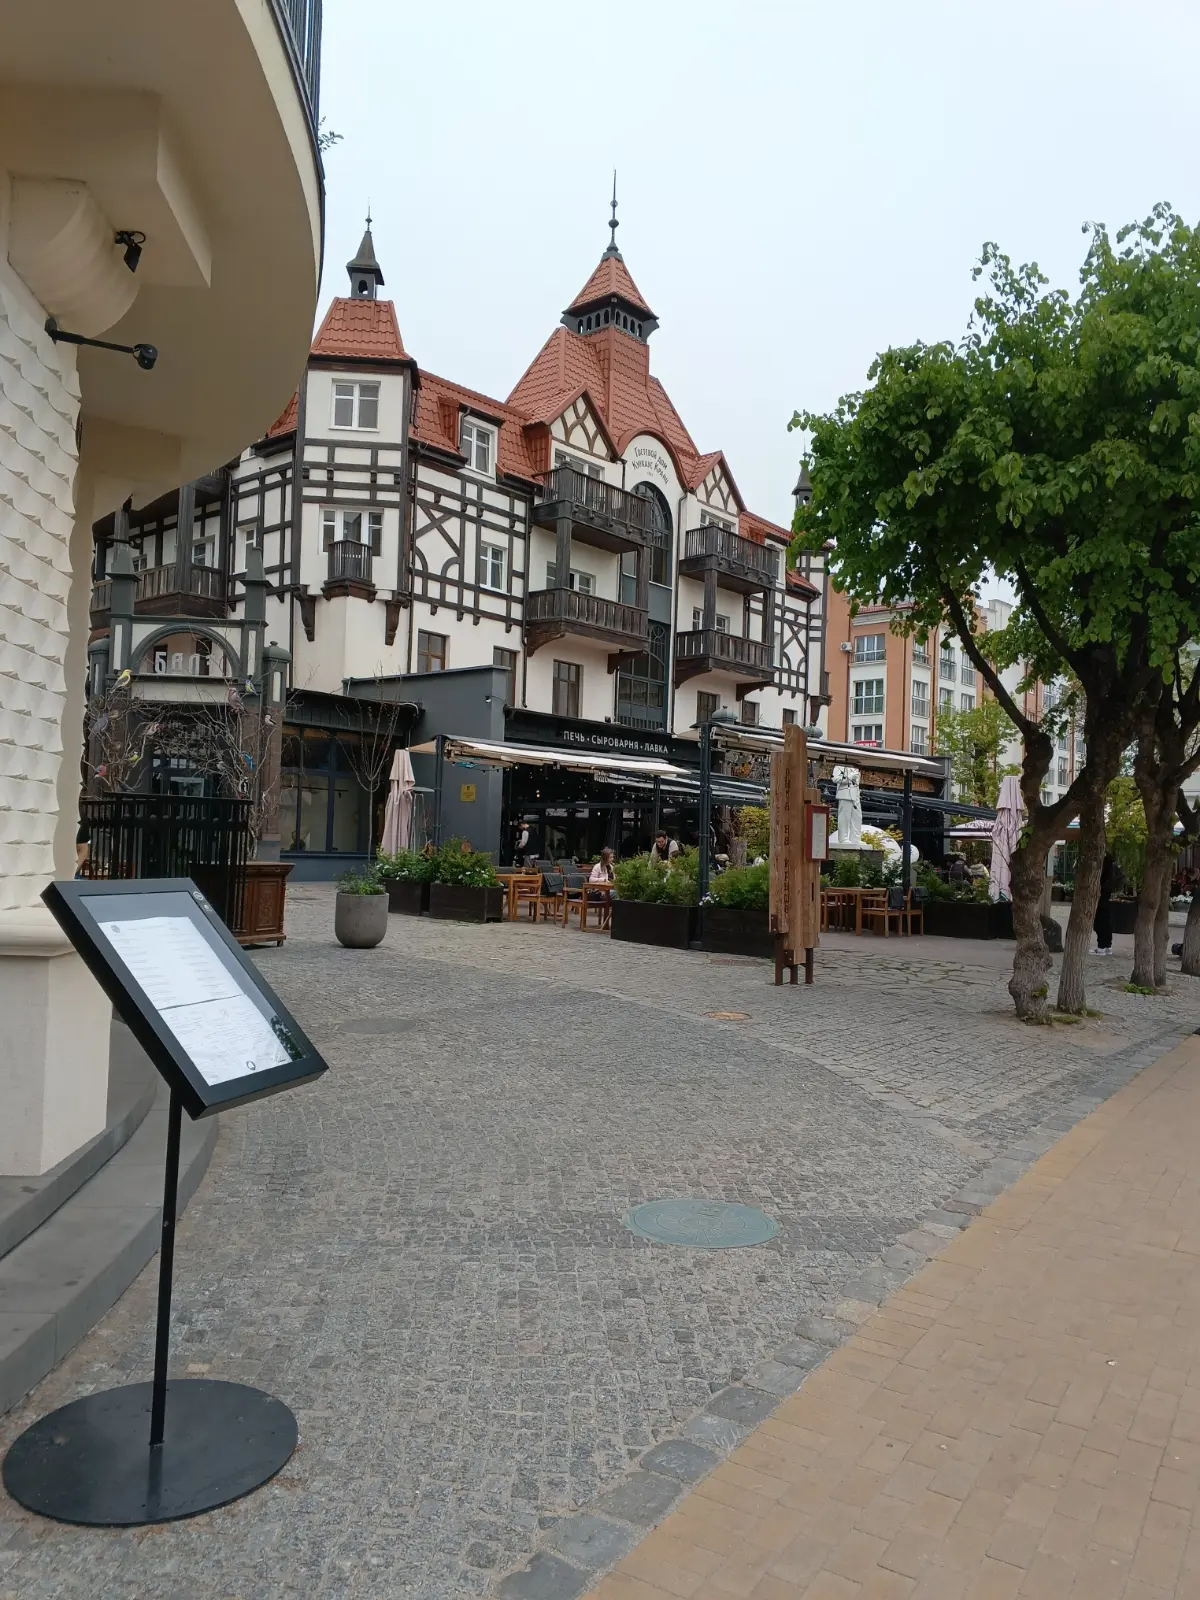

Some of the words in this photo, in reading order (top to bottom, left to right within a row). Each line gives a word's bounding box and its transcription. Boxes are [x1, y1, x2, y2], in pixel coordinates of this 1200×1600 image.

[563, 730, 585, 742] ПЕЧЬ
[591, 735, 639, 750] СЫРОВАРНЯ
[644, 742, 669, 754] ЛАВКА
